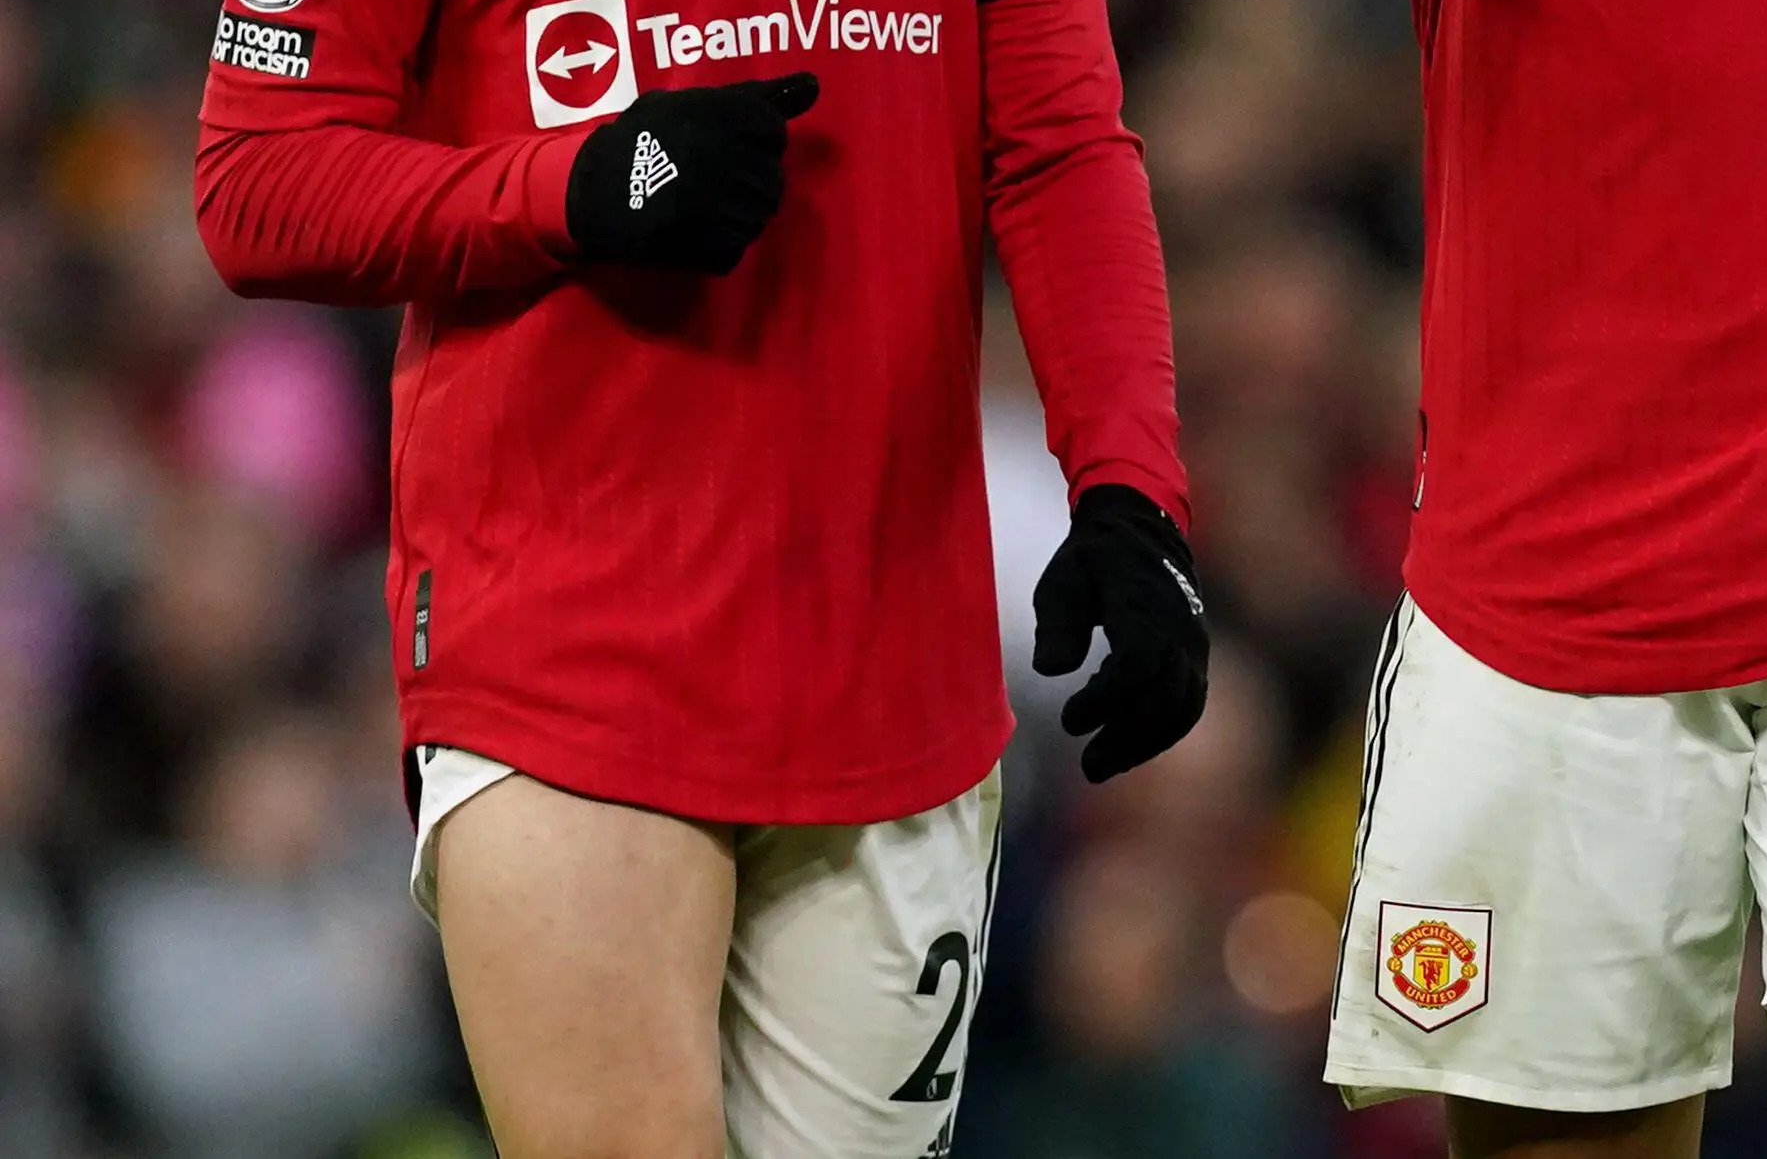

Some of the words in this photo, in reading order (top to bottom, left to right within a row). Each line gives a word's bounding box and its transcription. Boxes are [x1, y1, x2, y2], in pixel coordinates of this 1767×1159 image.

[236, 21, 302, 55] room
[231, 44, 310, 79] racism
[629, 131, 652, 210] adidas
[1397, 927, 1469, 958] MANCHESTER
[1405, 986, 1457, 1002] UNITED
